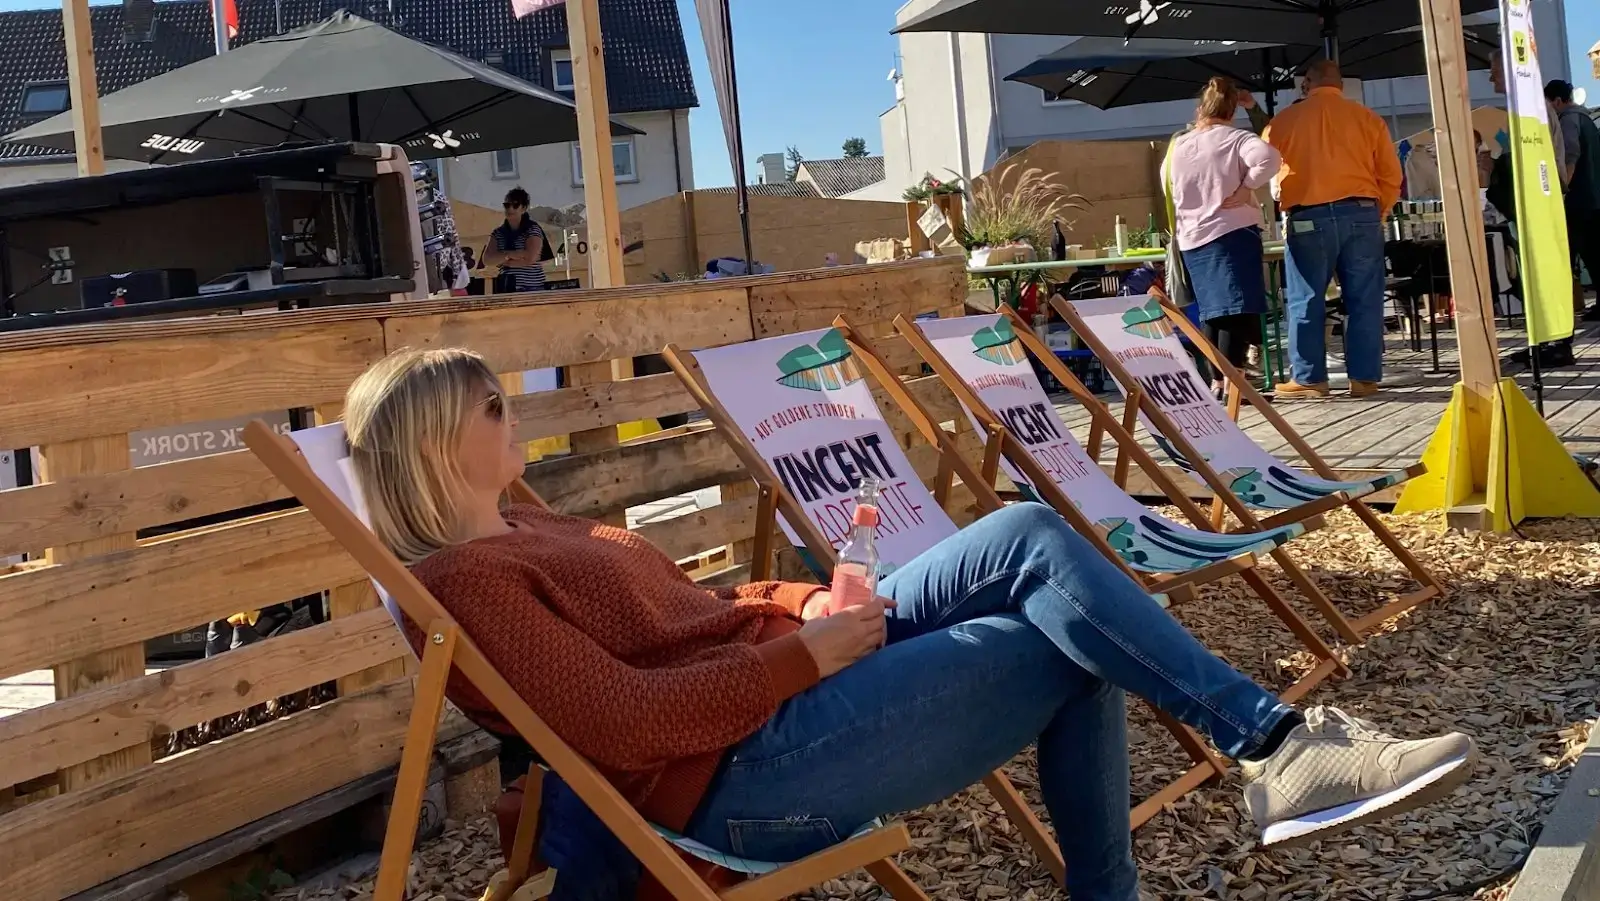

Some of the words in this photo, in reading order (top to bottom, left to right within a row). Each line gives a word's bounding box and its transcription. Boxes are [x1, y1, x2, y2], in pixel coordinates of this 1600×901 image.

[754, 419, 774, 440] AUF
[771, 405, 813, 429] GOLDENE
[812, 403, 857, 420] STUNDEN
